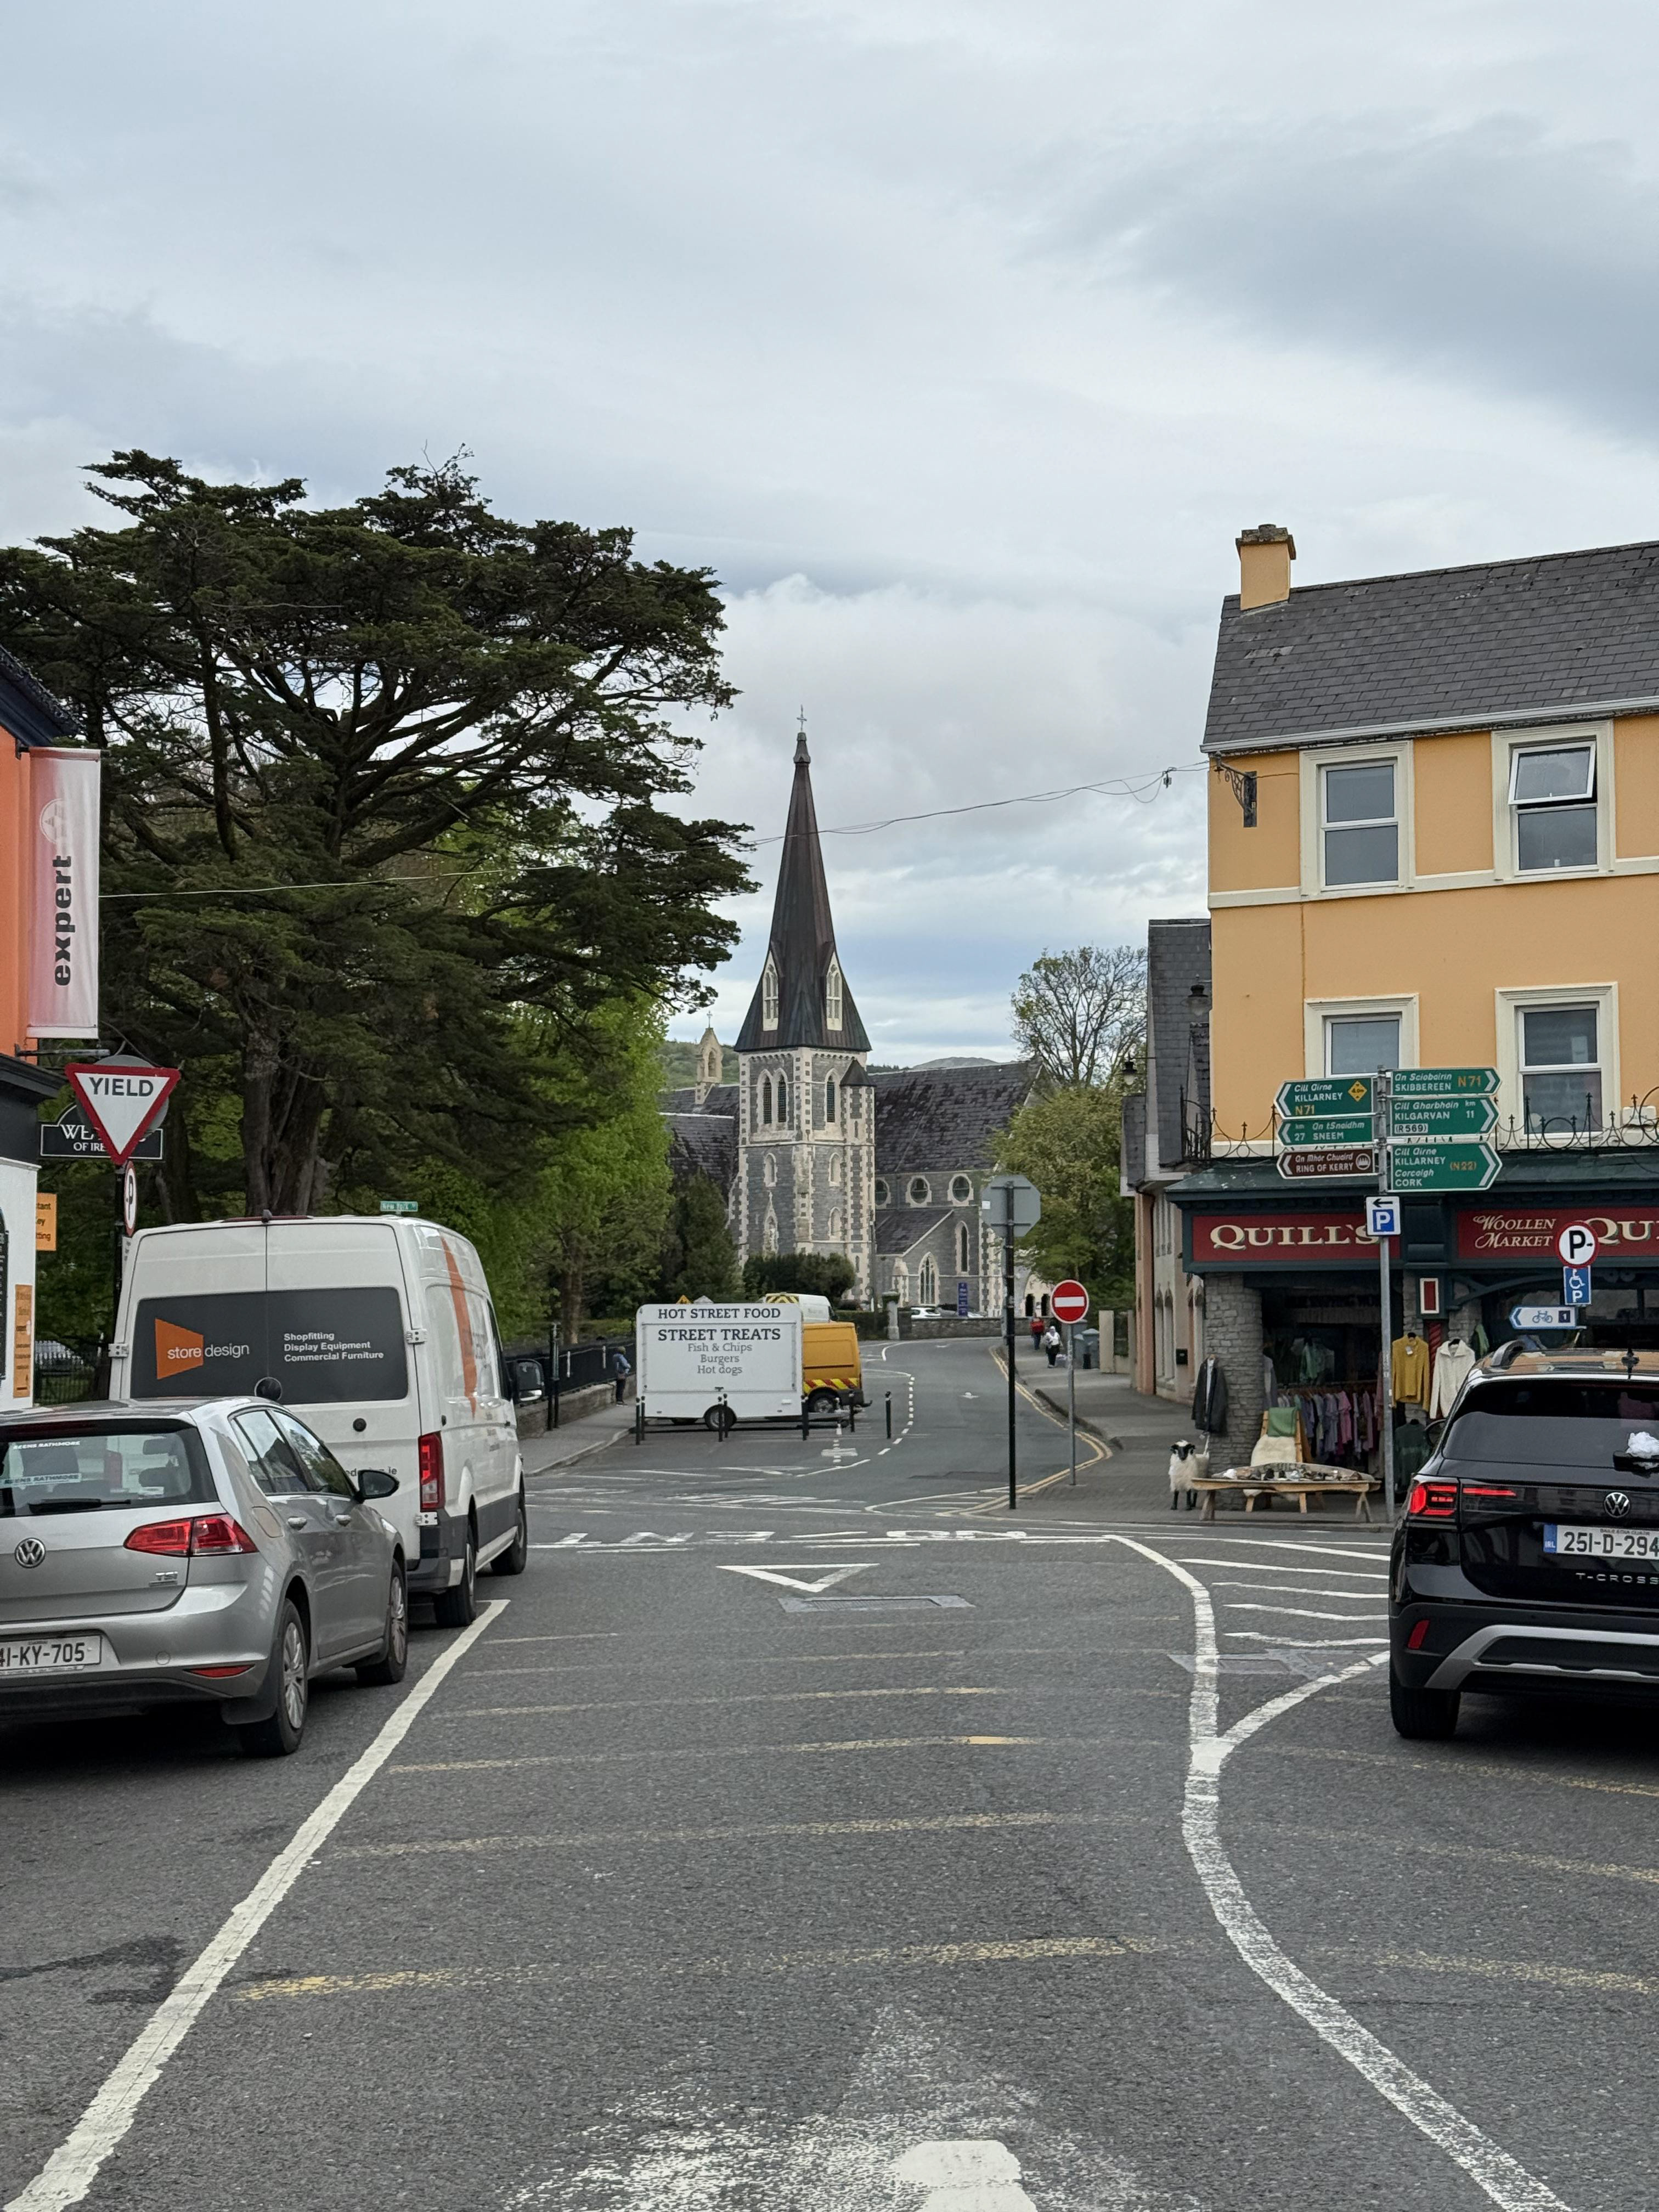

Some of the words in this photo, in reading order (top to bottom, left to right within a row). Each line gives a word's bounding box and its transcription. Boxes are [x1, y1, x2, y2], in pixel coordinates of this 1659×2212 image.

[53, 855, 76, 986] expert
[89, 1076, 154, 1097] YIELD
[1294, 1084, 1308, 1092] Cill
[1395, 1083, 1451, 1091] SKIBBEREEN
[1295, 1092, 1343, 1102] KILLARNEY
[1395, 1111, 1450, 1120] KILGARVAN
[1466, 1110, 1475, 1119] 11
[1327, 1121, 1365, 1130] tSnaidhm
[1395, 1124, 1427, 1133] (R569)
[1294, 1133, 1305, 1141] 27
[1313, 1132, 1344, 1141] SNEEM
[74, 1142, 88, 1152] OF
[1327, 1153, 1354, 1161] Chuaird
[1395, 1156, 1446, 1166] KILLARNEY
[1296, 1165, 1314, 1173] RING
[1329, 1163, 1354, 1171] KERRY
[1395, 1169, 1434, 1177] Corcaigh
[1376, 1211, 1391, 1230] P
[1584, 1217, 1659, 1245] QU
[1568, 1230, 1586, 1260] P
[1572, 1290, 1583, 1302] P
[658, 1309, 686, 1319] HOT
[690, 1308, 740, 1319] STREET
[744, 1308, 781, 1318] FOOD
[284, 1332, 335, 1342] Shopfitting
[658, 1329, 717, 1341] STREET
[720, 1328, 781, 1340] TREATS
[167, 1347, 201, 1359] store
[205, 1343, 250, 1358] design
[284, 1344, 318, 1352] Display
[320, 1341, 371, 1351] Equipment
[688, 1343, 709, 1352] Fish
[712, 1344, 719, 1352] &
[723, 1342, 753, 1353] Chips
[284, 1353, 339, 1362] Commercial
[342, 1351, 384, 1360] Furniture
[701, 1355, 740, 1365] Burgers
[697, 1365, 715, 1374] Hot
[719, 1364, 742, 1376] dogs
[1575, 1572, 1659, 1585] T-CROSS
